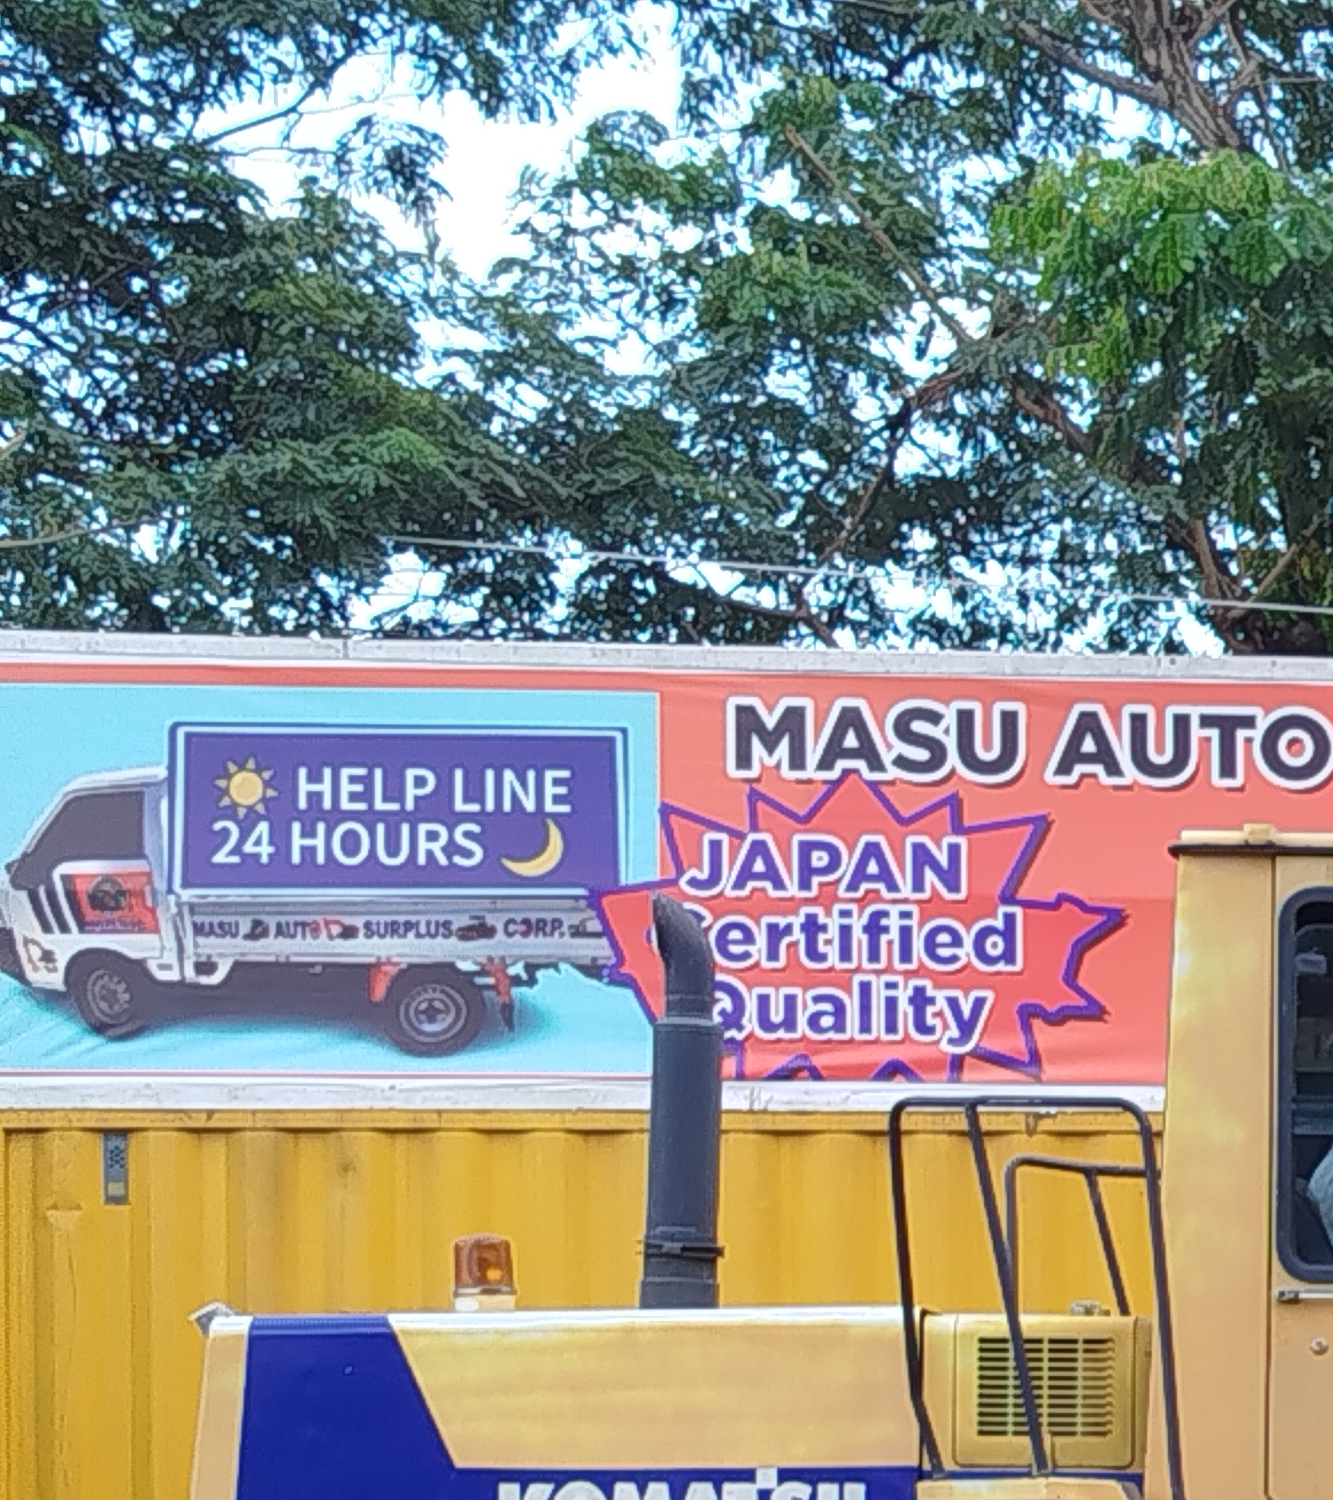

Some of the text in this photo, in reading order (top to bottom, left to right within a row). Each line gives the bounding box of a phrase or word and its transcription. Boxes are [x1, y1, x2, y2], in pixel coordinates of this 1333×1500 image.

[732, 699, 1023, 779] MASU
[297, 766, 572, 813] HELP LINE
[210, 820, 485, 868] 24 HOURS
[684, 838, 966, 896] JAPAN
[362, 918, 454, 940] SURPLUS
[645, 907, 1020, 967] ertified
